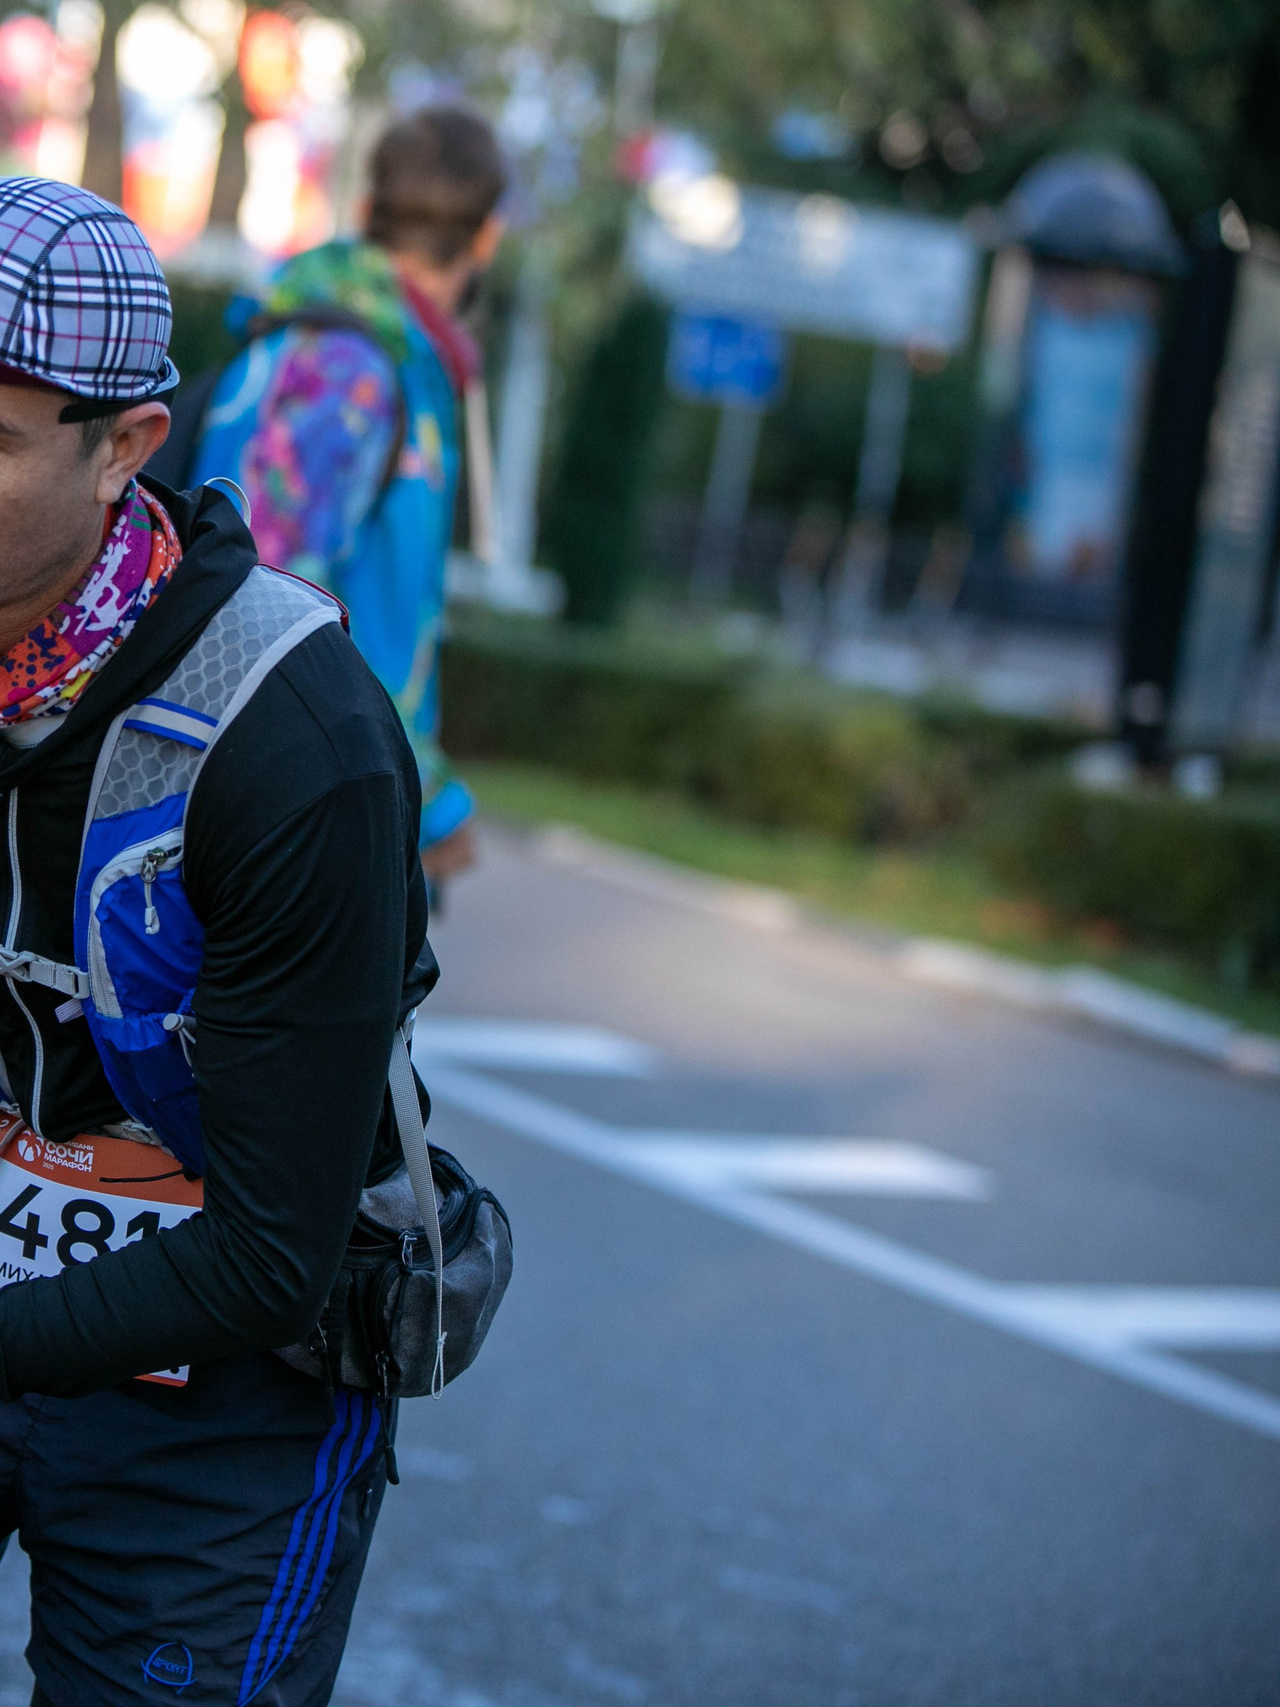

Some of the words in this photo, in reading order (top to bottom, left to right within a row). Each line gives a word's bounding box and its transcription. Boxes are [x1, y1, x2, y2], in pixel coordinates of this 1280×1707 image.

[43, 1152, 92, 1173] МАРАФОН
[45, 1141, 94, 1165] СОЧИ
[152, 1657, 188, 1675] SPORT
